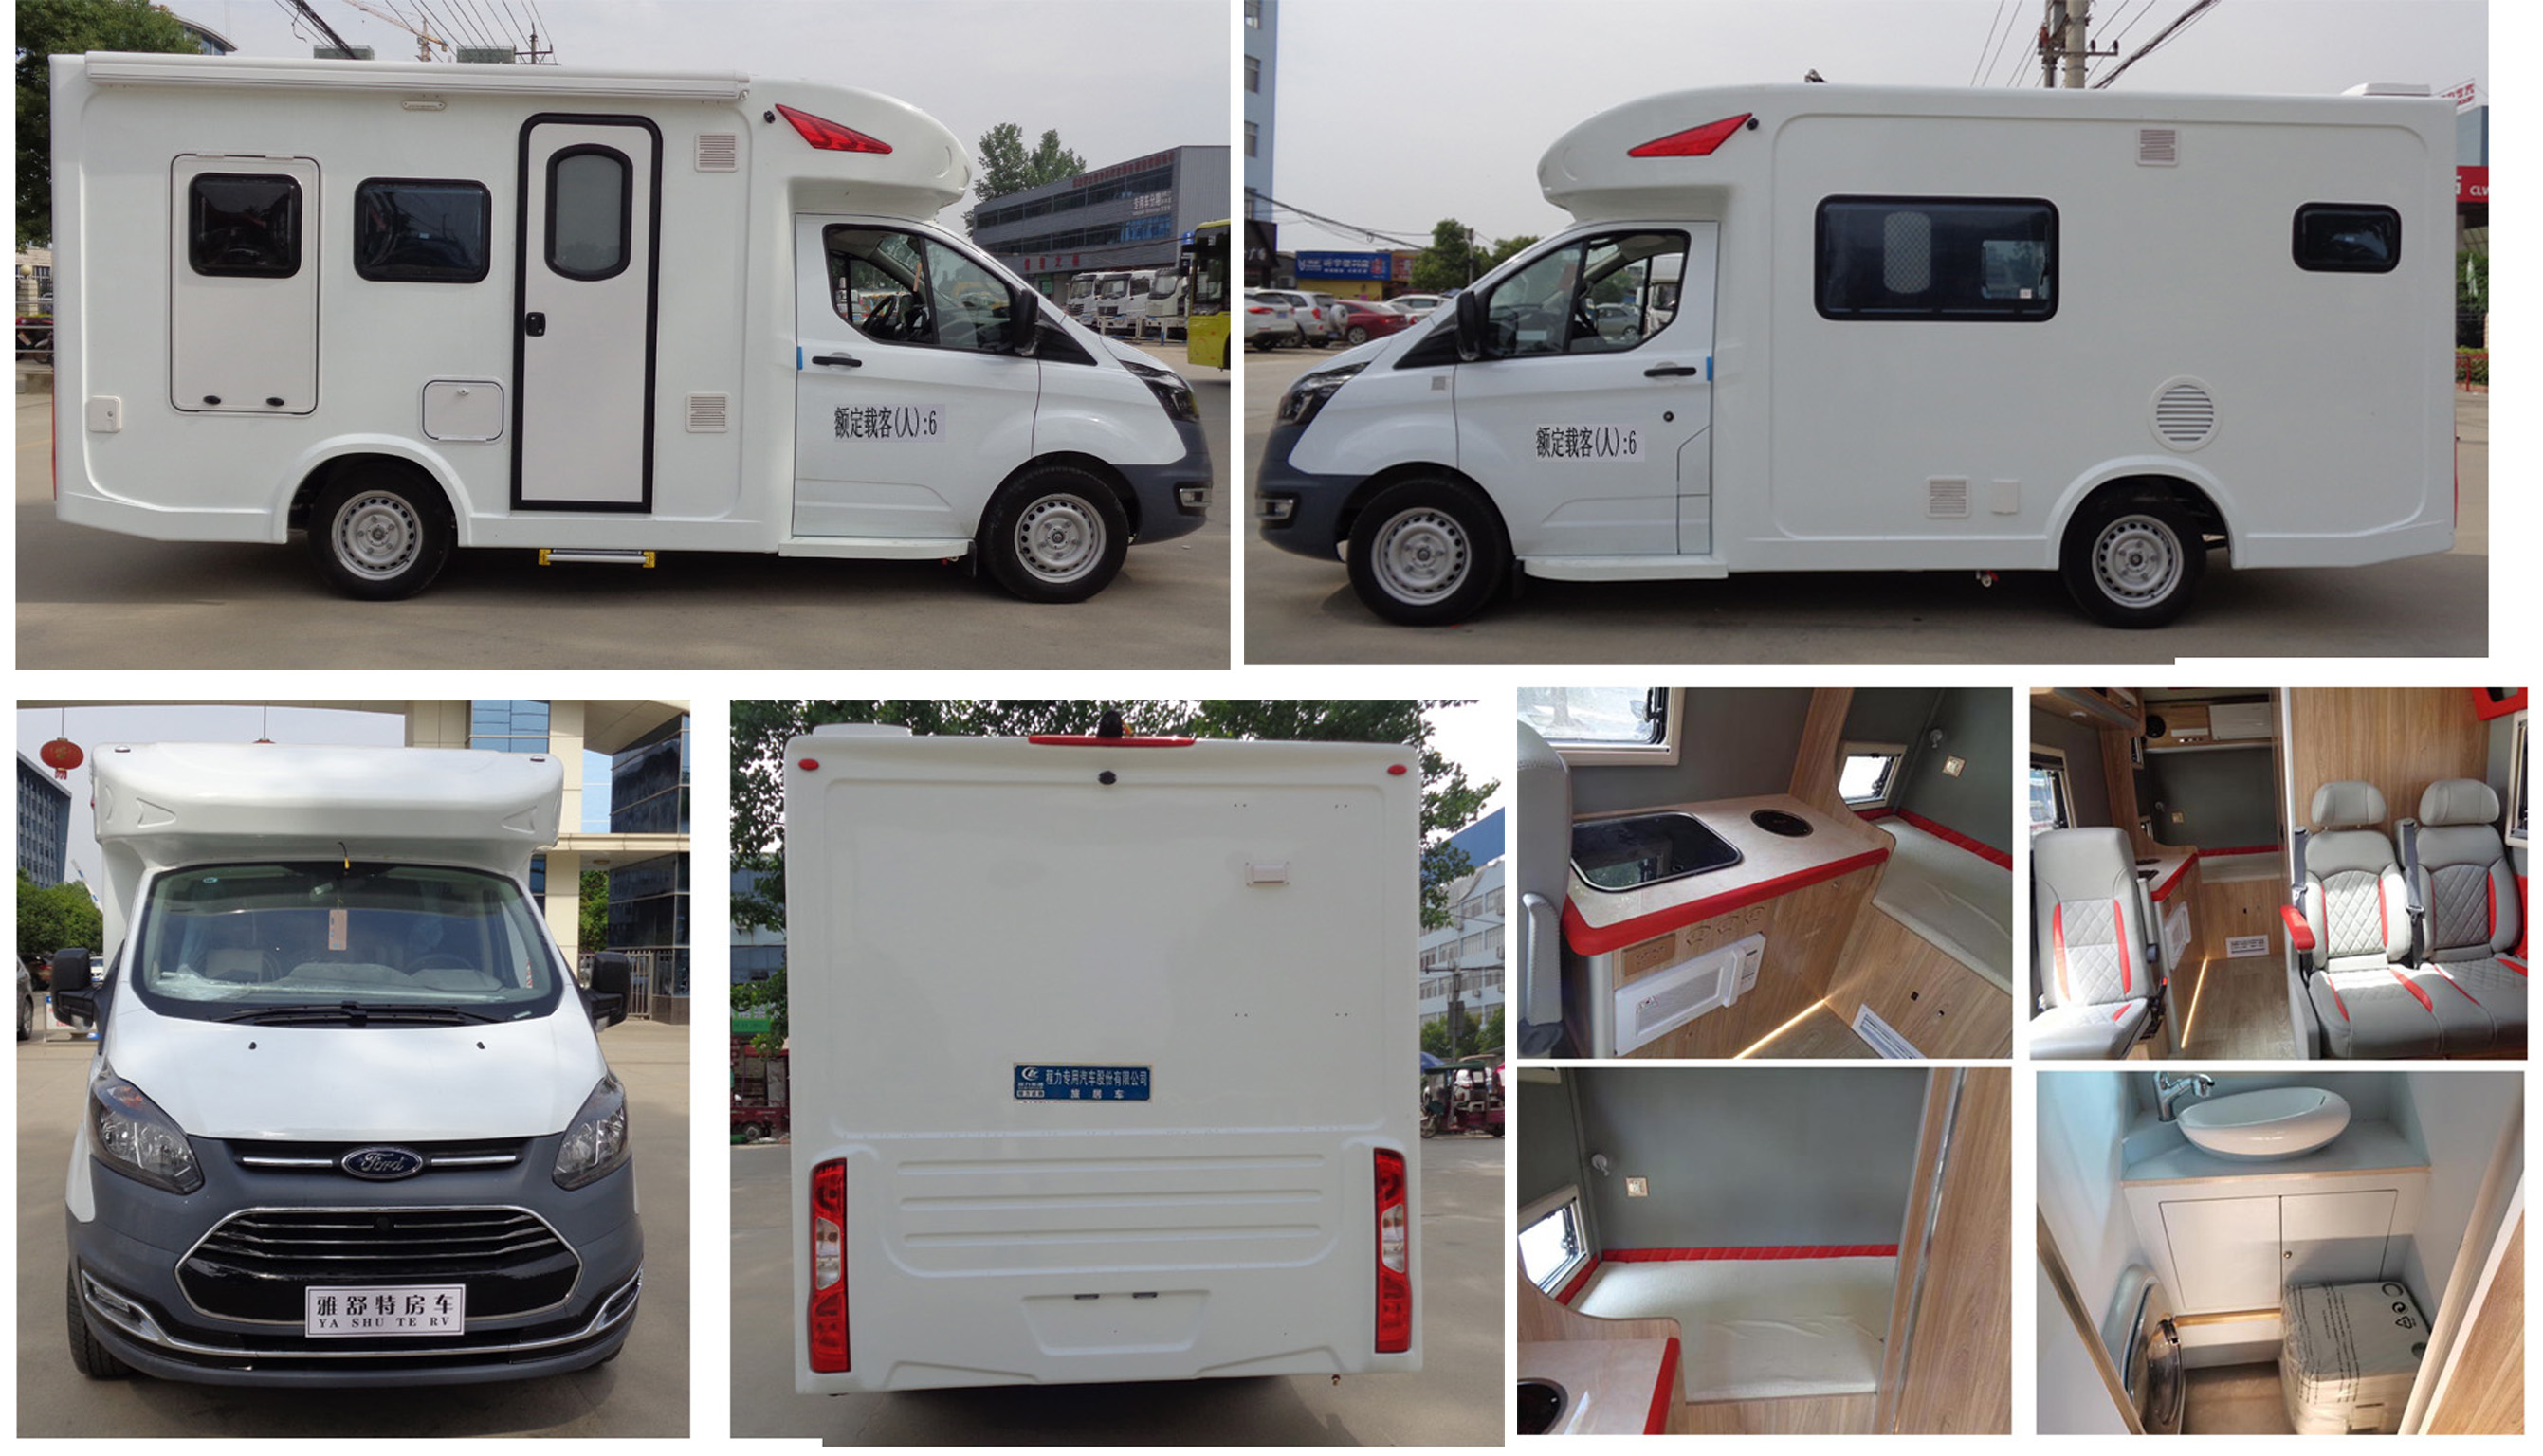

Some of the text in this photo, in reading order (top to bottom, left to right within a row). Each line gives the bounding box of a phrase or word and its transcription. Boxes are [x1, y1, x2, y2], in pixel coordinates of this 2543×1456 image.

[1045, 1069, 1148, 1087] 程力专用汽车股份有限公司
[360, 1152, 405, 1173] Ford
[316, 1294, 455, 1317] 雅舒特房车
[319, 1316, 450, 1329] YA SHU TE RV
